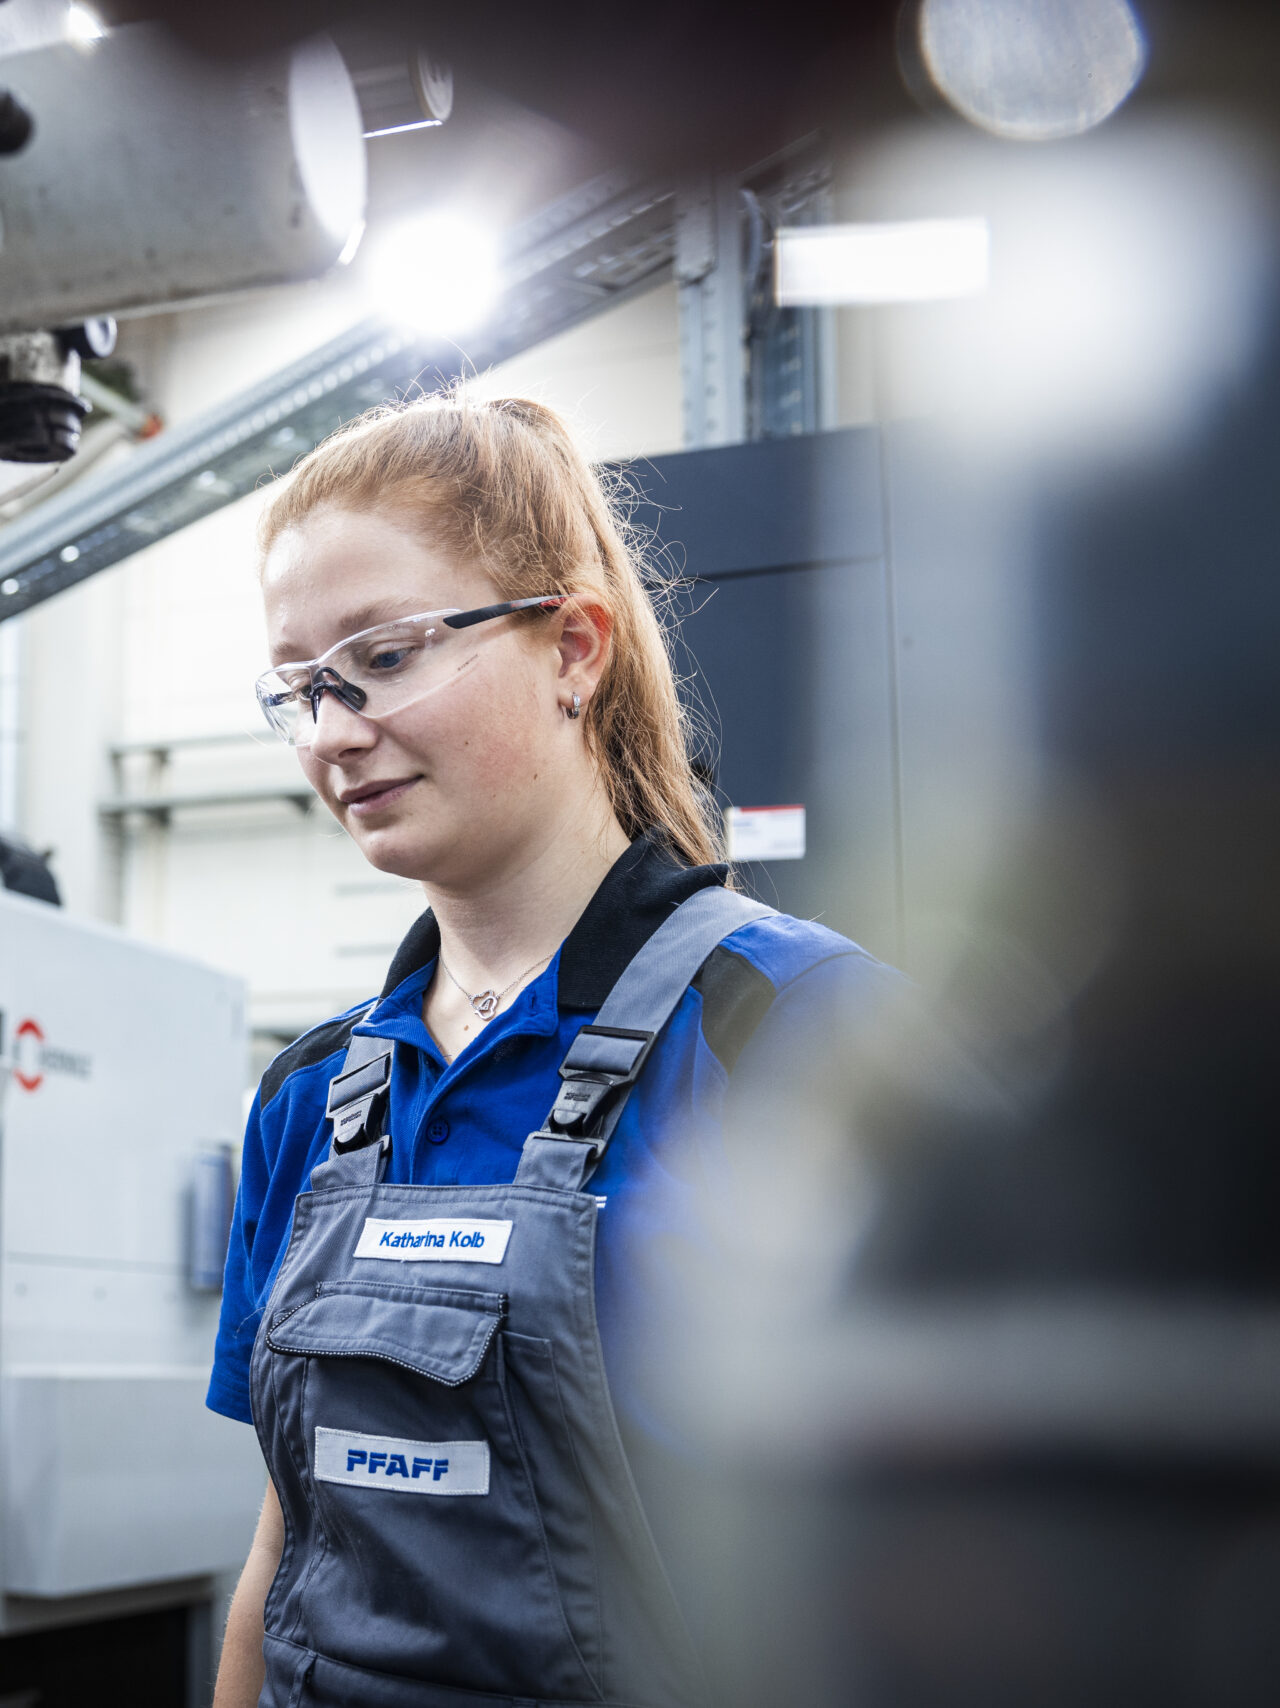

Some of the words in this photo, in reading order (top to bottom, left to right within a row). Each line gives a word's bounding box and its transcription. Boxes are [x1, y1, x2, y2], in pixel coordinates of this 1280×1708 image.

[379, 1231, 446, 1248] Katharina
[449, 1231, 485, 1248] Kolb
[346, 1449, 449, 1481] PFAFF
